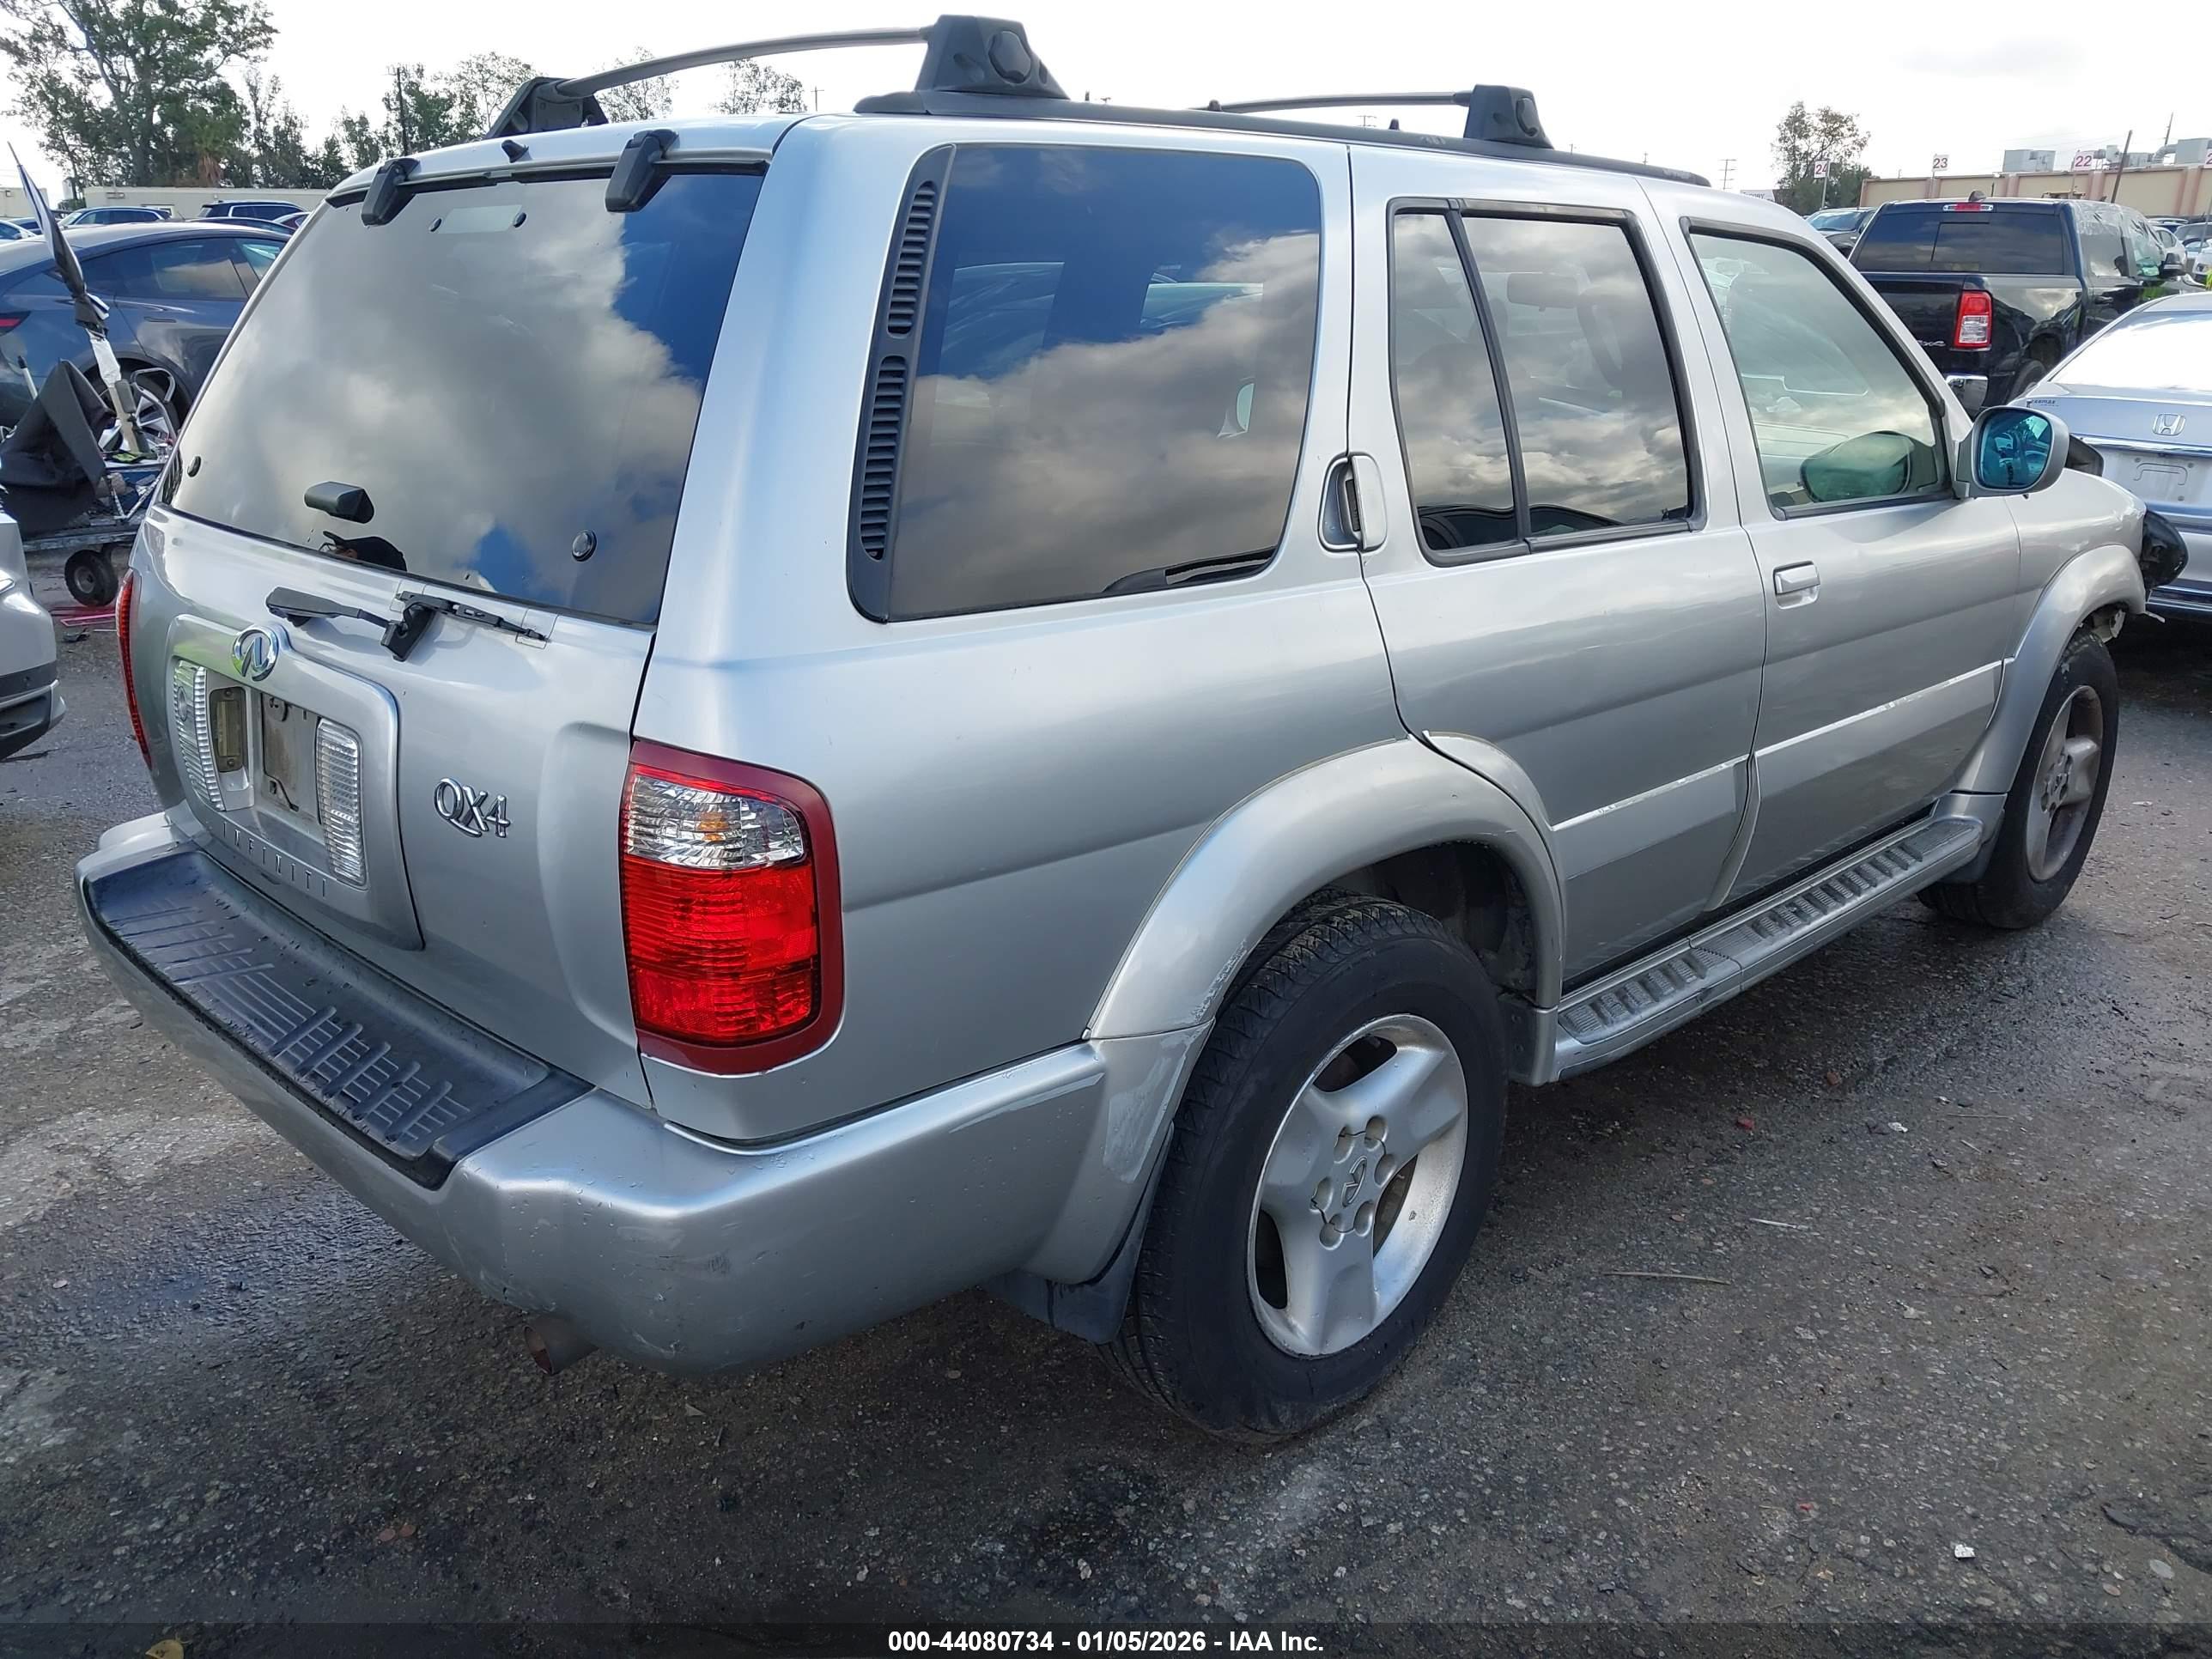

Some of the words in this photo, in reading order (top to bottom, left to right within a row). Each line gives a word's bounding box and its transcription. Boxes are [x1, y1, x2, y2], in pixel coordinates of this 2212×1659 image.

[1933, 157, 1948, 169] 23
[2075, 155, 2092, 167] 22
[434, 777, 511, 838] QX4
[222, 821, 327, 899] INFINITI
